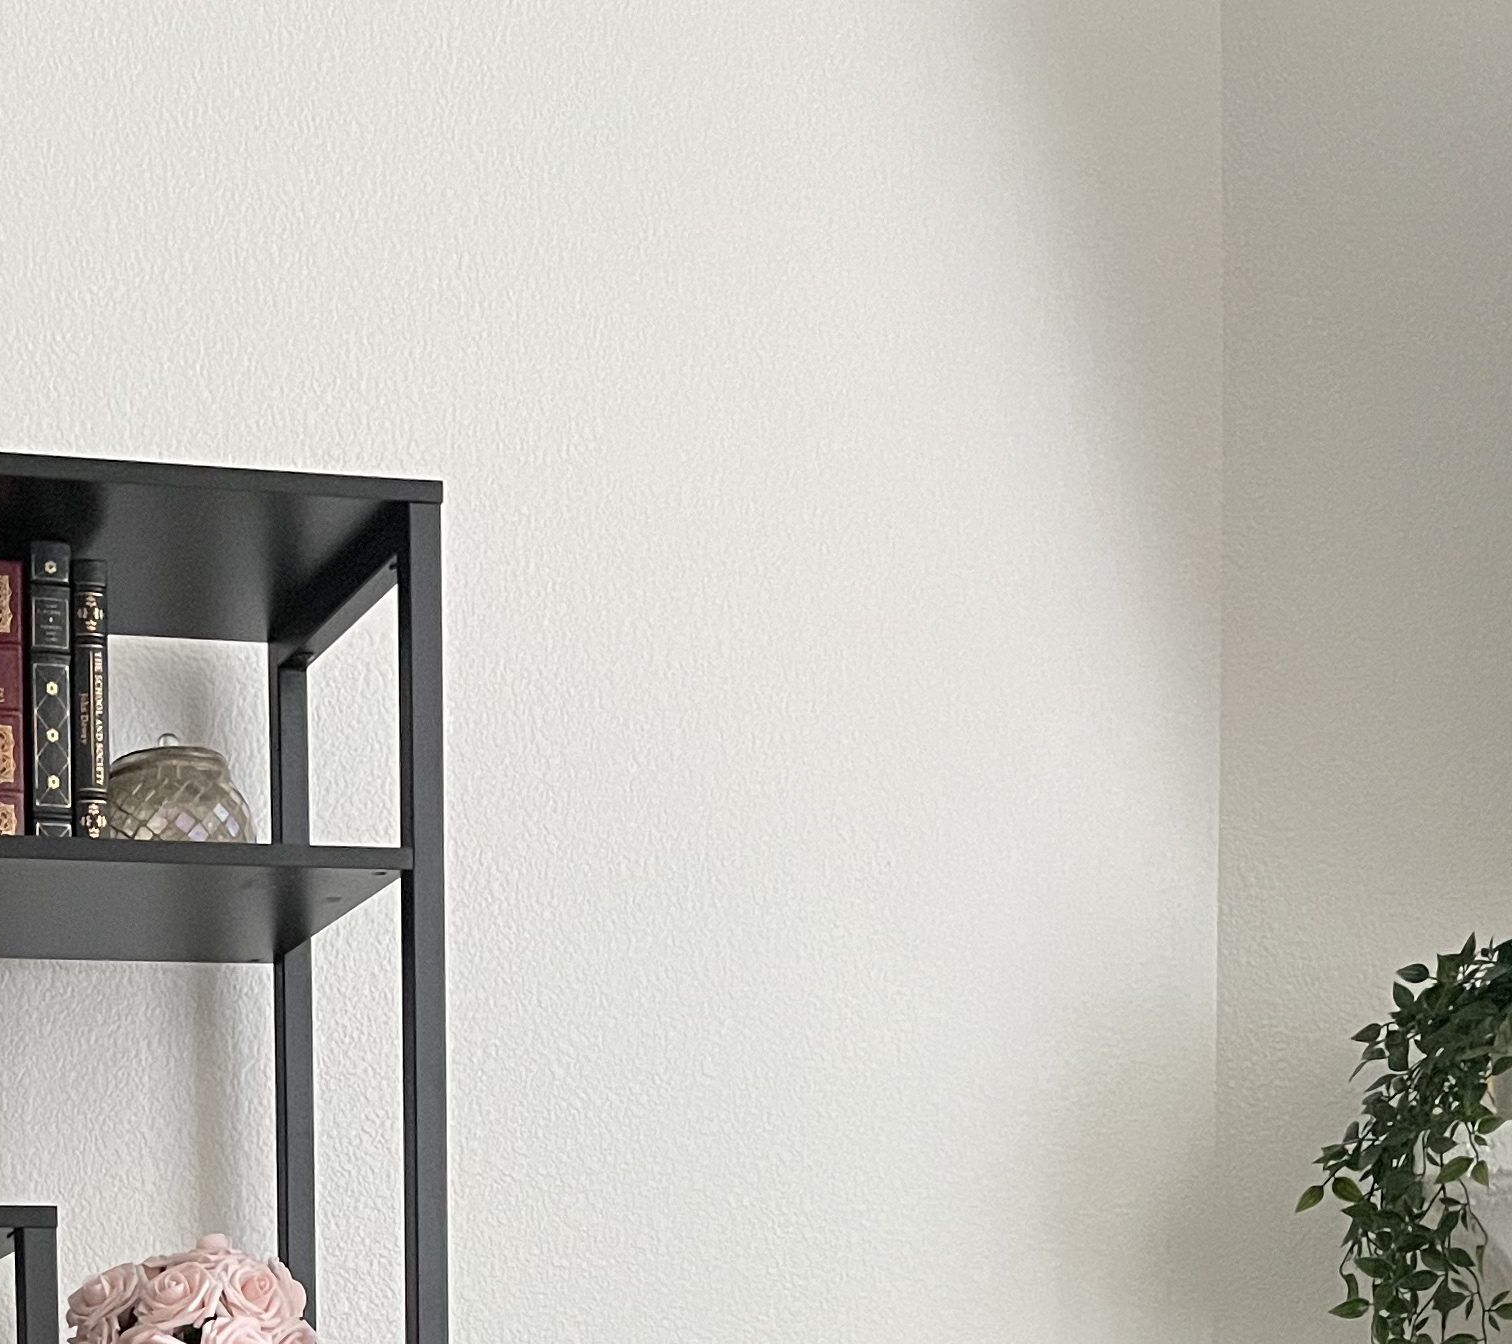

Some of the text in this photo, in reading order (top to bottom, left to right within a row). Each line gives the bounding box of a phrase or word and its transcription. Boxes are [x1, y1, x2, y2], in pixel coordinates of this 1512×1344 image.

[94, 674, 103, 716] SCHOOL
[95, 718, 104, 741] AND
[95, 742, 104, 786] SOCIETY
